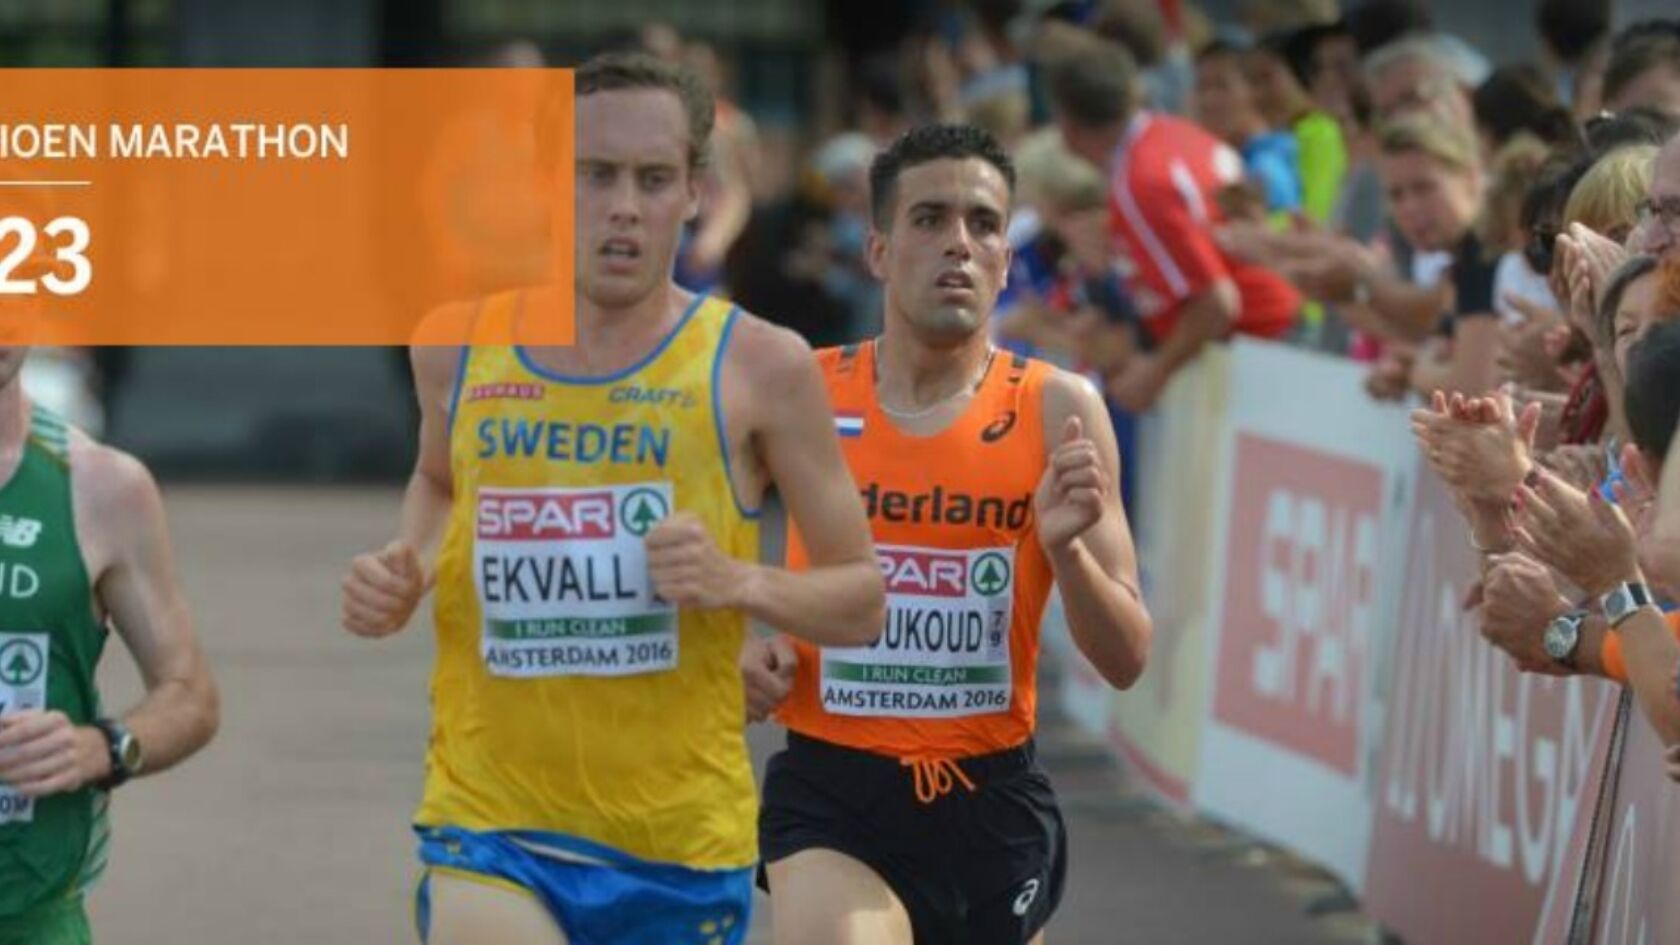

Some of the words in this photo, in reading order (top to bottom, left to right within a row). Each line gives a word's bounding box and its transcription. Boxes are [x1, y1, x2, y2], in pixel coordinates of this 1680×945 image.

[477, 417, 670, 469] SWEDEN
[478, 499, 612, 537] SPAR
[482, 554, 638, 602] EKVALL
[527, 620, 566, 638] RUN
[569, 617, 627, 637] CLEAN
[625, 642, 673, 665] 2016
[872, 665, 907, 684] RUN
[912, 667, 967, 687] CLEAN
[825, 687, 958, 711] AMSTERDAM
[964, 689, 1007, 708] 2016
